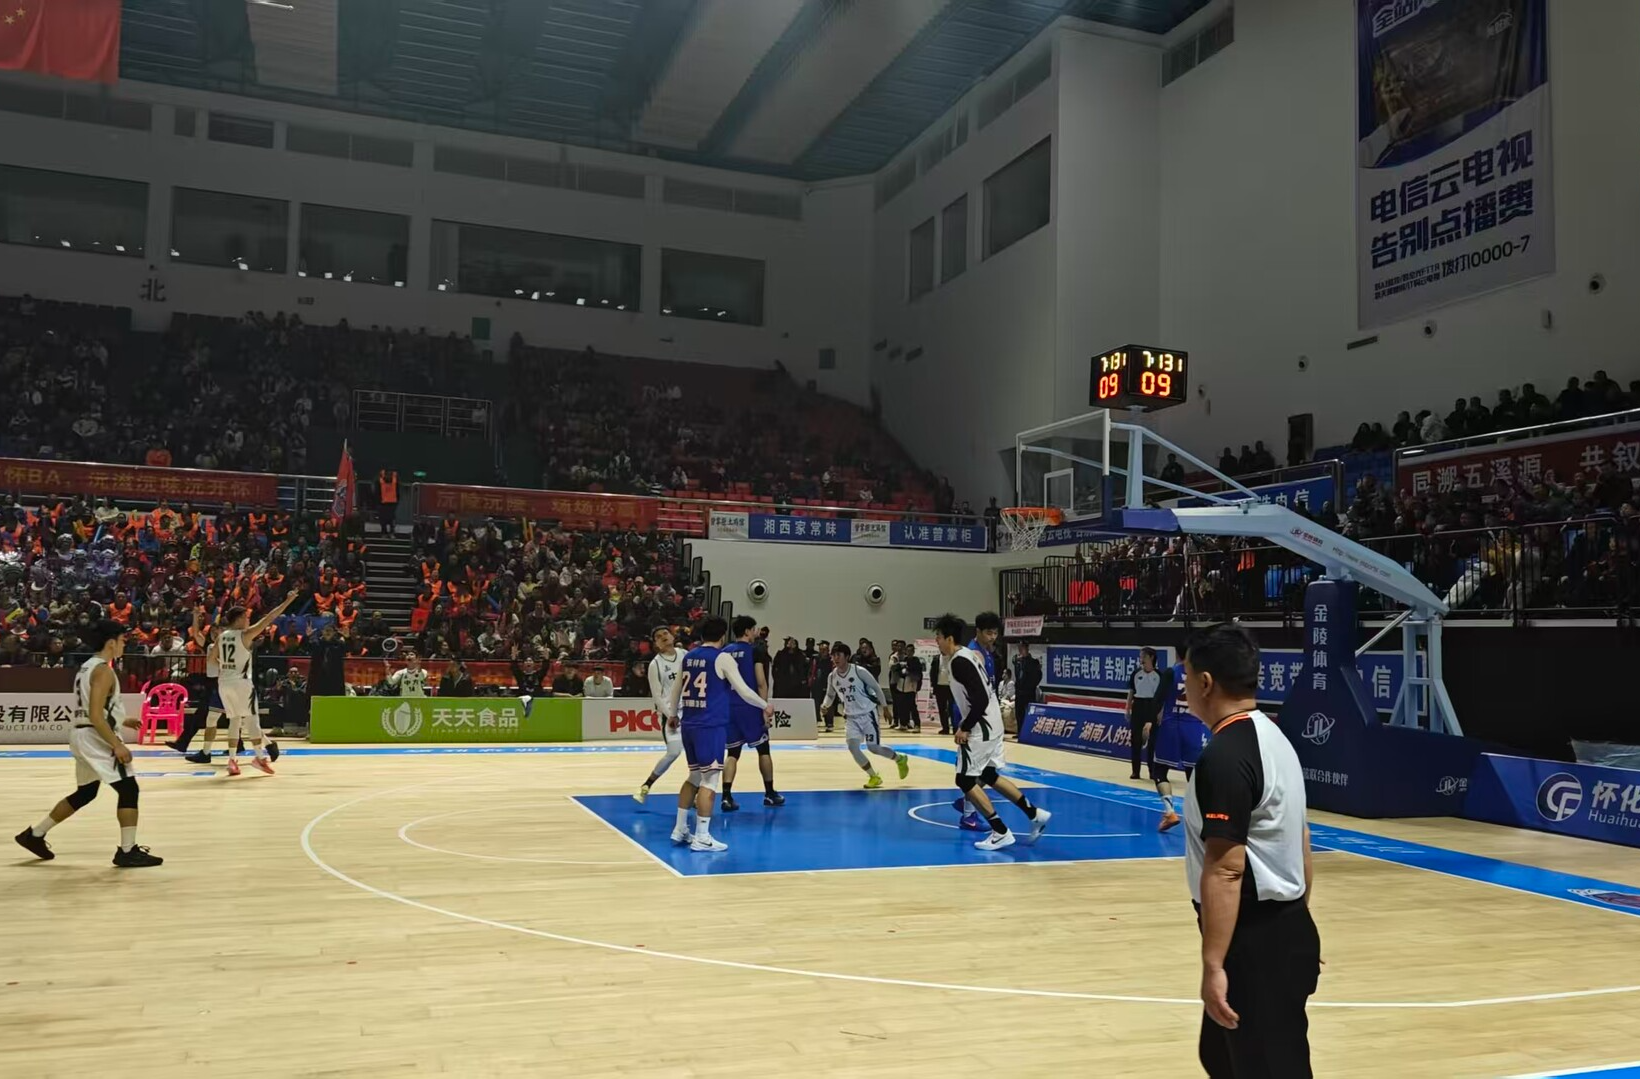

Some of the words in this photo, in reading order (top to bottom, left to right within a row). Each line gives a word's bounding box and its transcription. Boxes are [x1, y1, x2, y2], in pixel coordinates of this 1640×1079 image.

[1371, 130, 1533, 223] 电信云电视
[1371, 179, 1533, 269] 告别点播费
[140, 279, 166, 302] 北
[1099, 373, 1119, 399] 09
[1142, 371, 1171, 397] 09
[763, 518, 837, 537] 湘西家常味
[903, 526, 972, 543] 认准曾掌柜
[222, 644, 235, 663] 12
[1312, 604, 1329, 691] 金陵体育
[1053, 655, 1100, 680] 电信云电视
[1104, 656, 1141, 682] 告别点
[682, 671, 708, 698] 24
[431, 708, 519, 728] 天天食品
[1031, 716, 1077, 738] 湖南银行
